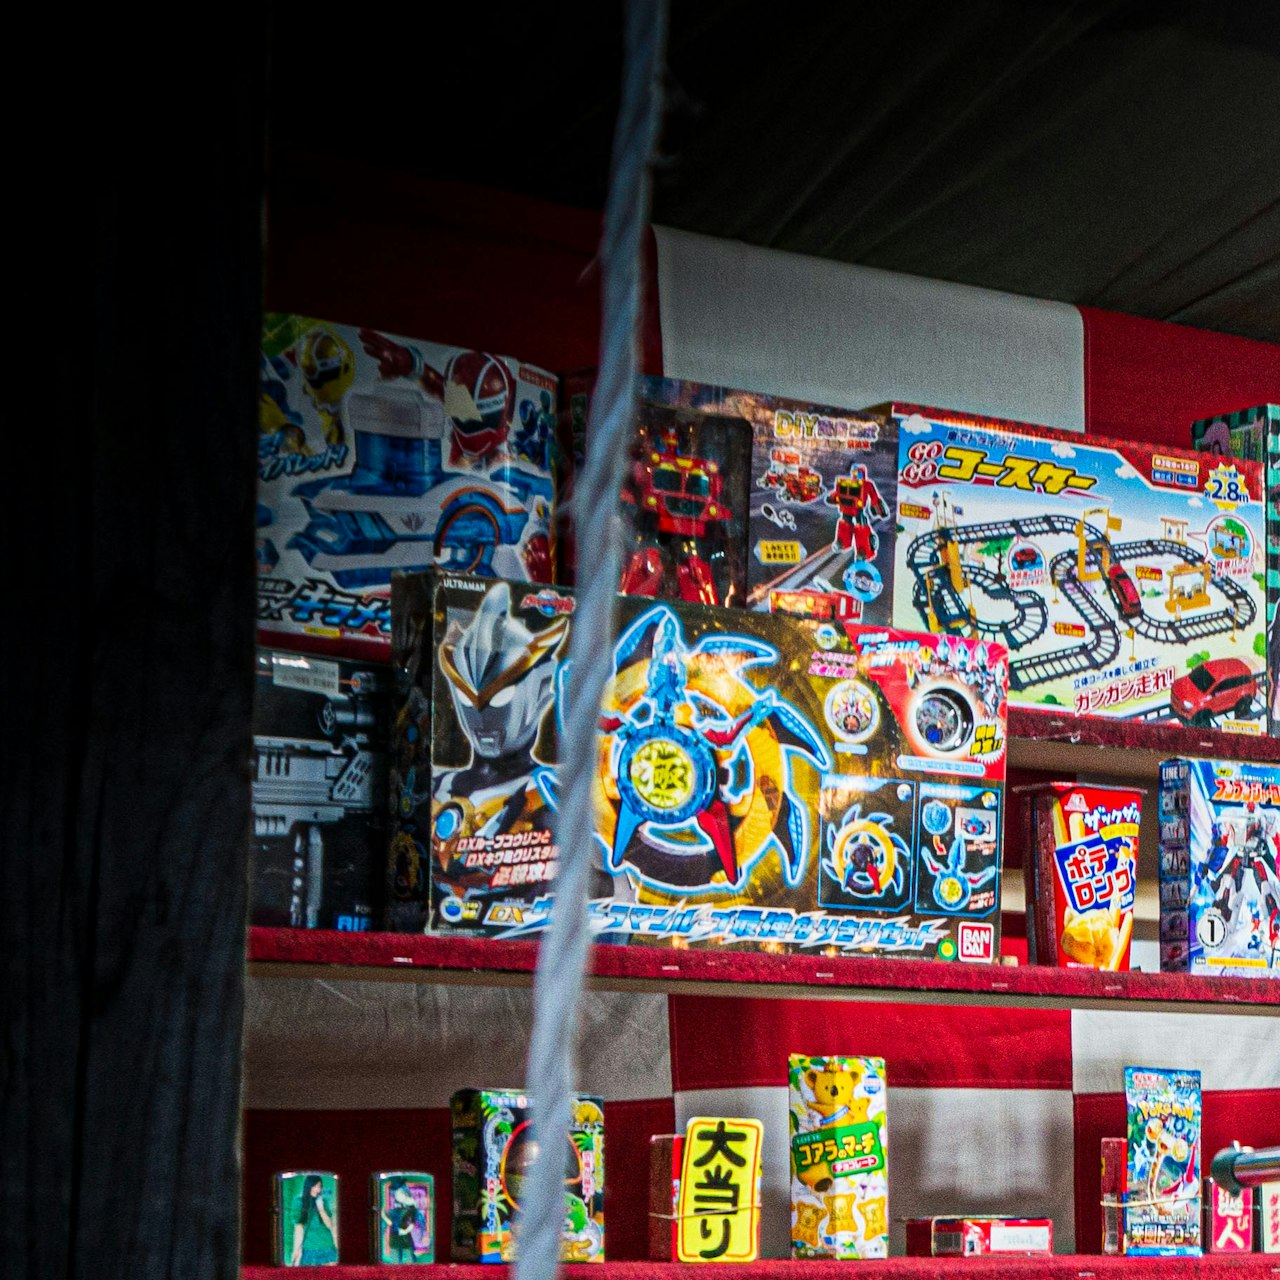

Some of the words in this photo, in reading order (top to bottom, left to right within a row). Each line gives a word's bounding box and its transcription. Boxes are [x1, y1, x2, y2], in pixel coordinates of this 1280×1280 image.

[775, 411, 818, 438] DIY
[937, 446, 1098, 495] コースター
[443, 579, 486, 592] ULTRAMAN
[1074, 668, 1176, 717] ガンガン走れ!
[1066, 845, 1110, 881] ポテ
[1071, 861, 1132, 909] ロング
[488, 905, 525, 924] DX
[962, 929, 990, 943] BAN
[963, 942, 984, 956] DAI
[799, 1131, 876, 1167] コアラのマーチ
[834, 1156, 878, 1173] チョコレート
[693, 1120, 747, 1259] 大当り
